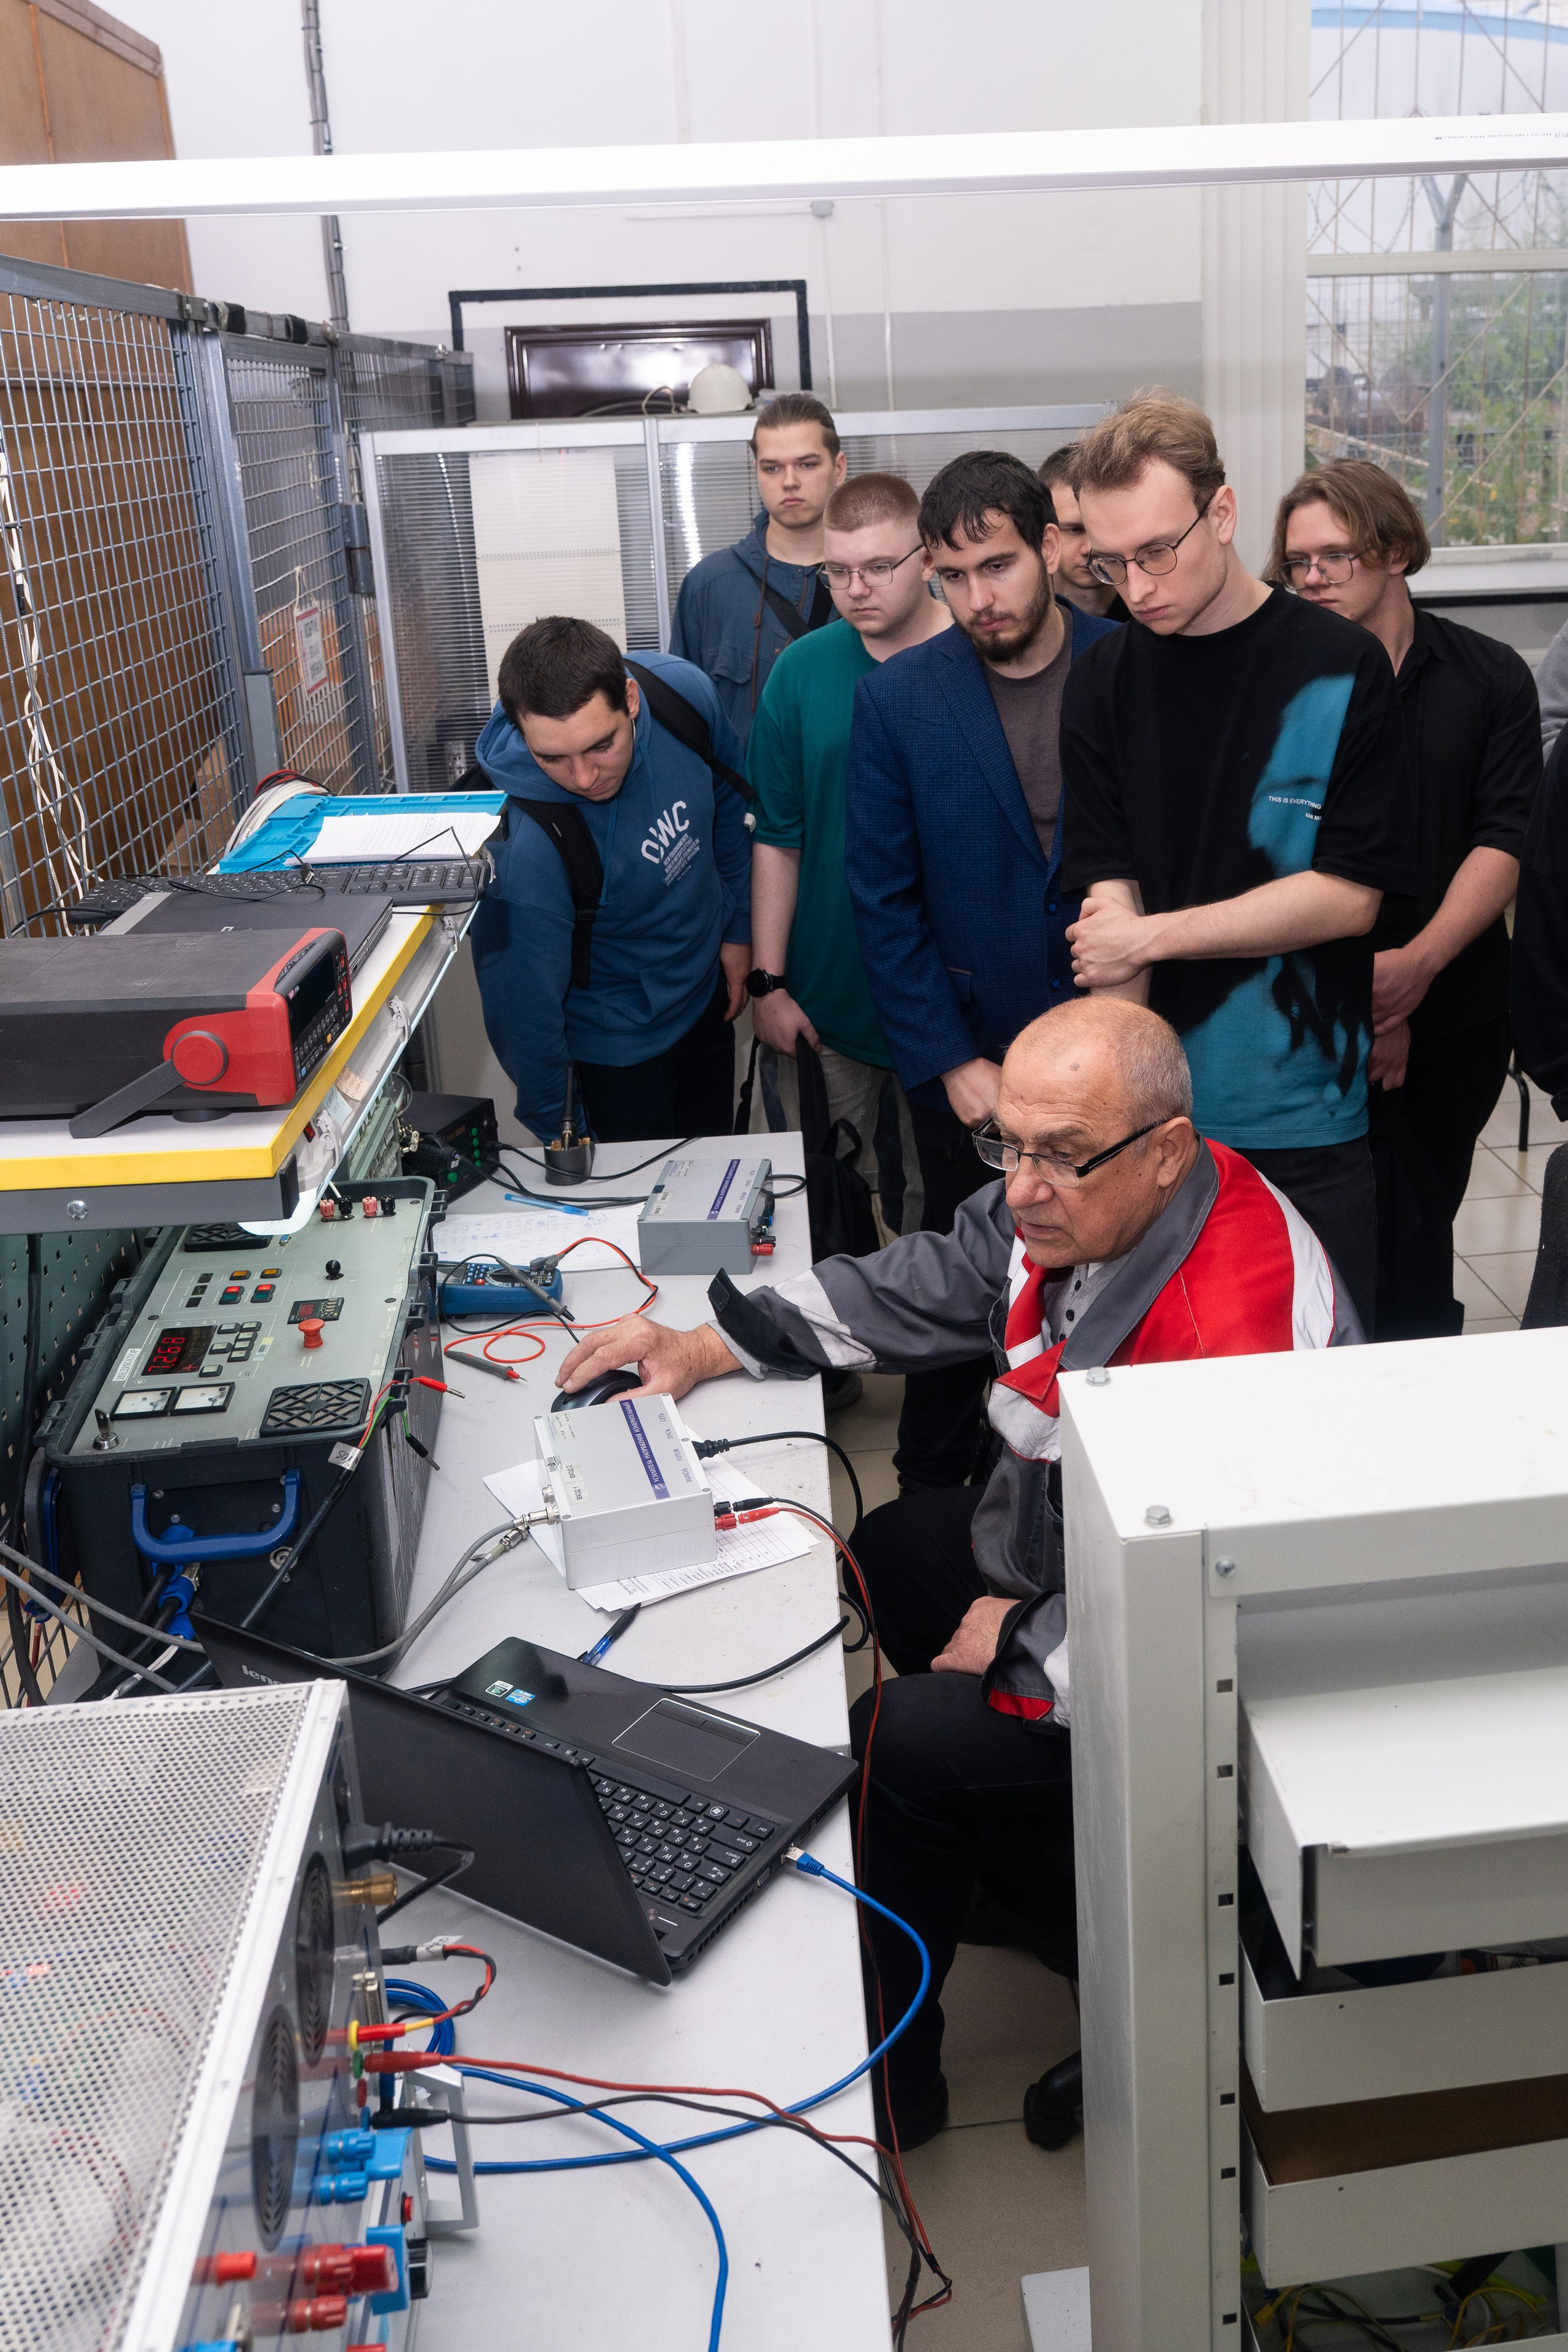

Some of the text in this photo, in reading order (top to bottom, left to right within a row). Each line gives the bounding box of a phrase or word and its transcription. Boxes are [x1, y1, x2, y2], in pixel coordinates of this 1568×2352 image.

[1289, 798, 1321, 810] EVERYTHING
[669, 833, 689, 859] TOURNAMENTS
[148, 1337, 186, 1371] 7.268
[116, 1349, 138, 1380] ИНДИКАТОР
[658, 1413, 666, 1422] СЕТЬ
[665, 1428, 674, 1439] ПУСК
[622, 1401, 660, 1482] УСИЛИТЕЛЬ НАПРЯЖЕНИЯ ИЗМЕРИТЕЛЬНЫЙ
[673, 1449, 684, 1461] ГОТОВ
[682, 1468, 692, 1482] ВЫХОД
